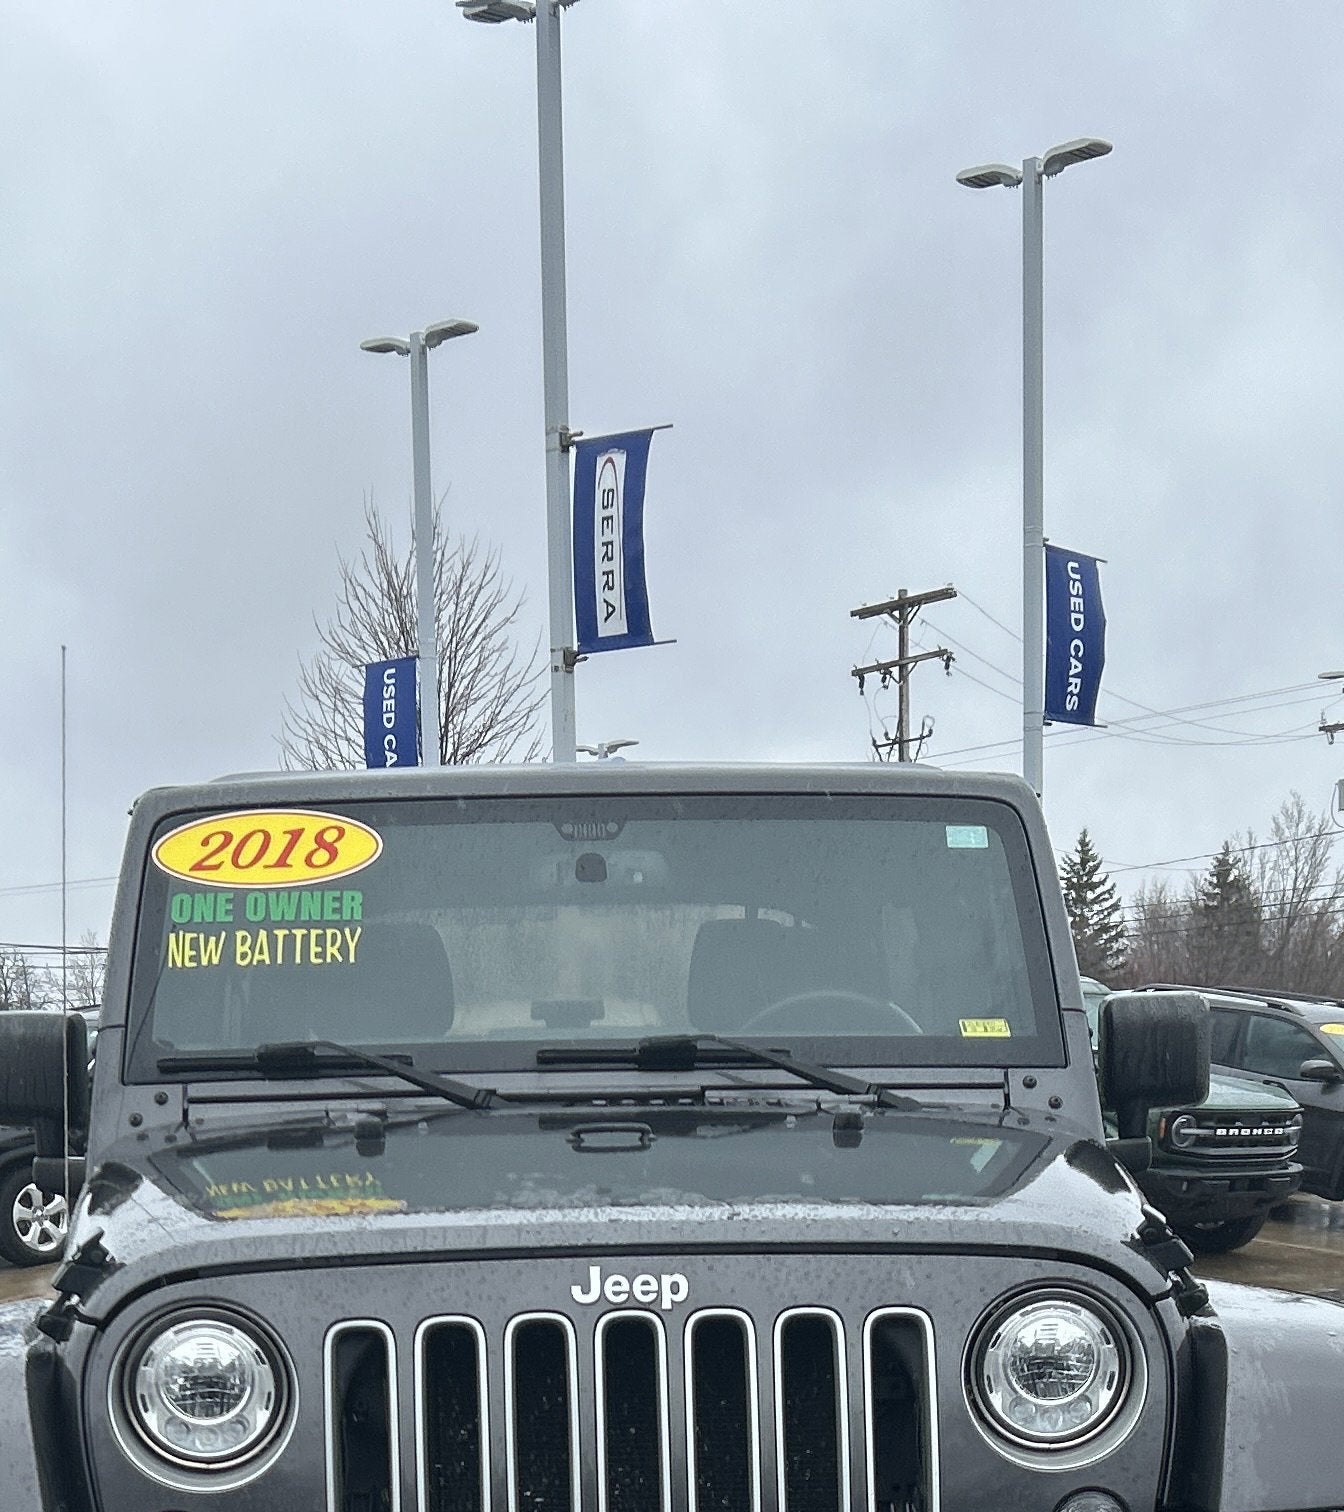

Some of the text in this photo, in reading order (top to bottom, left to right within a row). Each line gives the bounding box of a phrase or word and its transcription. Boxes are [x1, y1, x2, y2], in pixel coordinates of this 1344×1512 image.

[601, 488, 616, 623] SERRA
[1065, 560, 1085, 712] USED CARS
[382, 667, 396, 729] USED
[189, 826, 346, 872] 2018
[171, 891, 364, 924] ONE OWNER
[168, 927, 362, 968] NEW BATTERY
[570, 1265, 689, 1310] Jeep
